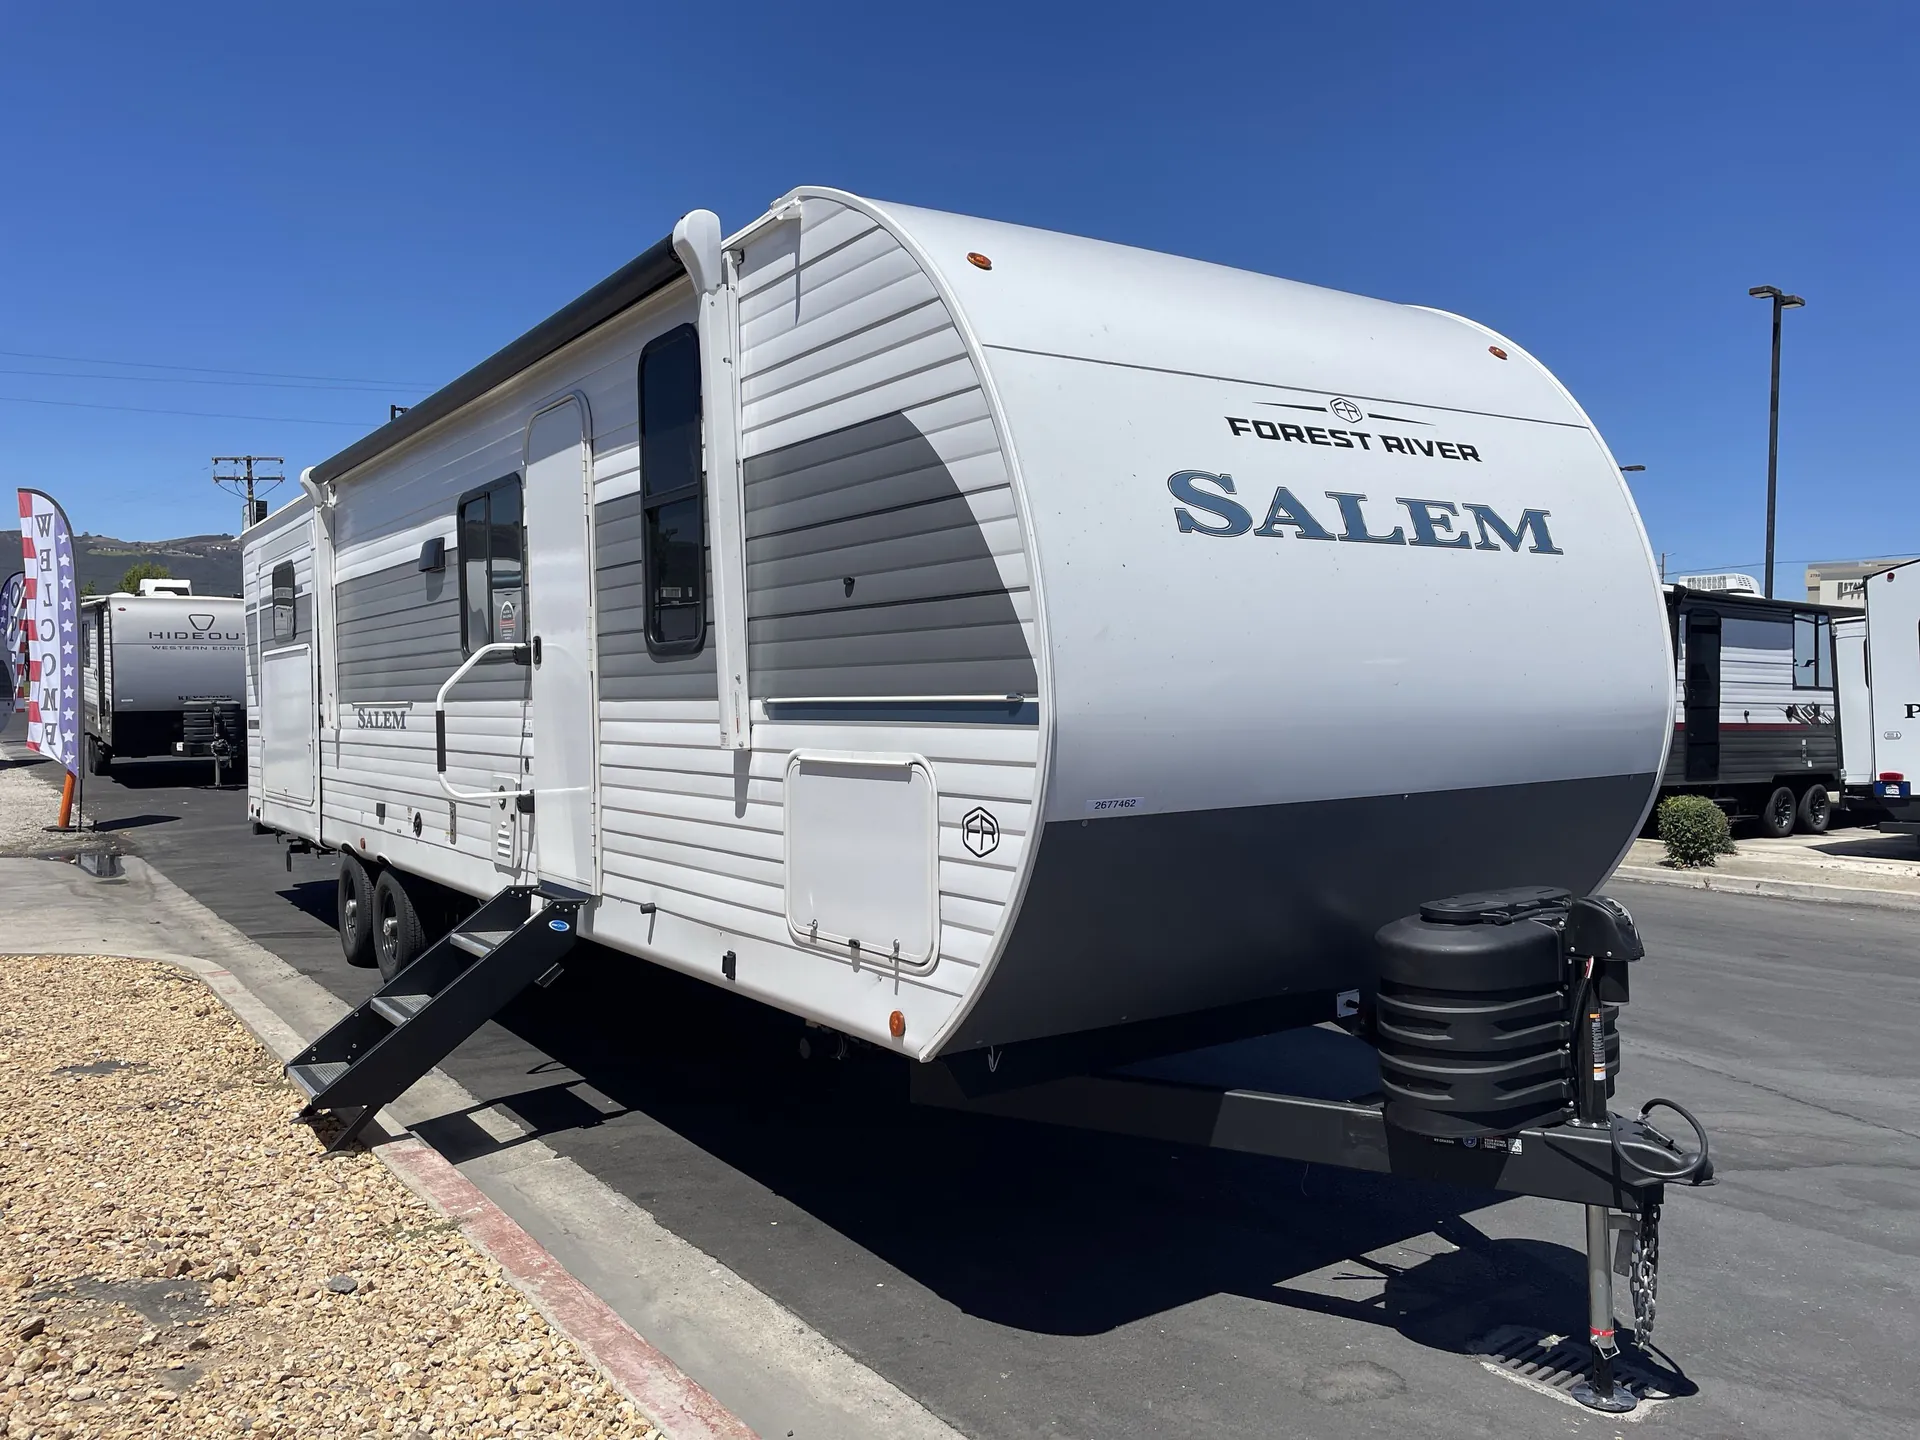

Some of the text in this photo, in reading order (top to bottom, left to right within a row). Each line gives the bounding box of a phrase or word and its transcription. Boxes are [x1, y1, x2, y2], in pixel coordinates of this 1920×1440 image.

[1225, 415, 1483, 463] FOREST RIVER
[1167, 469, 1564, 556] SALEM
[149, 631, 245, 641] HIDEOU
[357, 708, 407, 730] SALEM
[1094, 799, 1136, 810] 2677462
